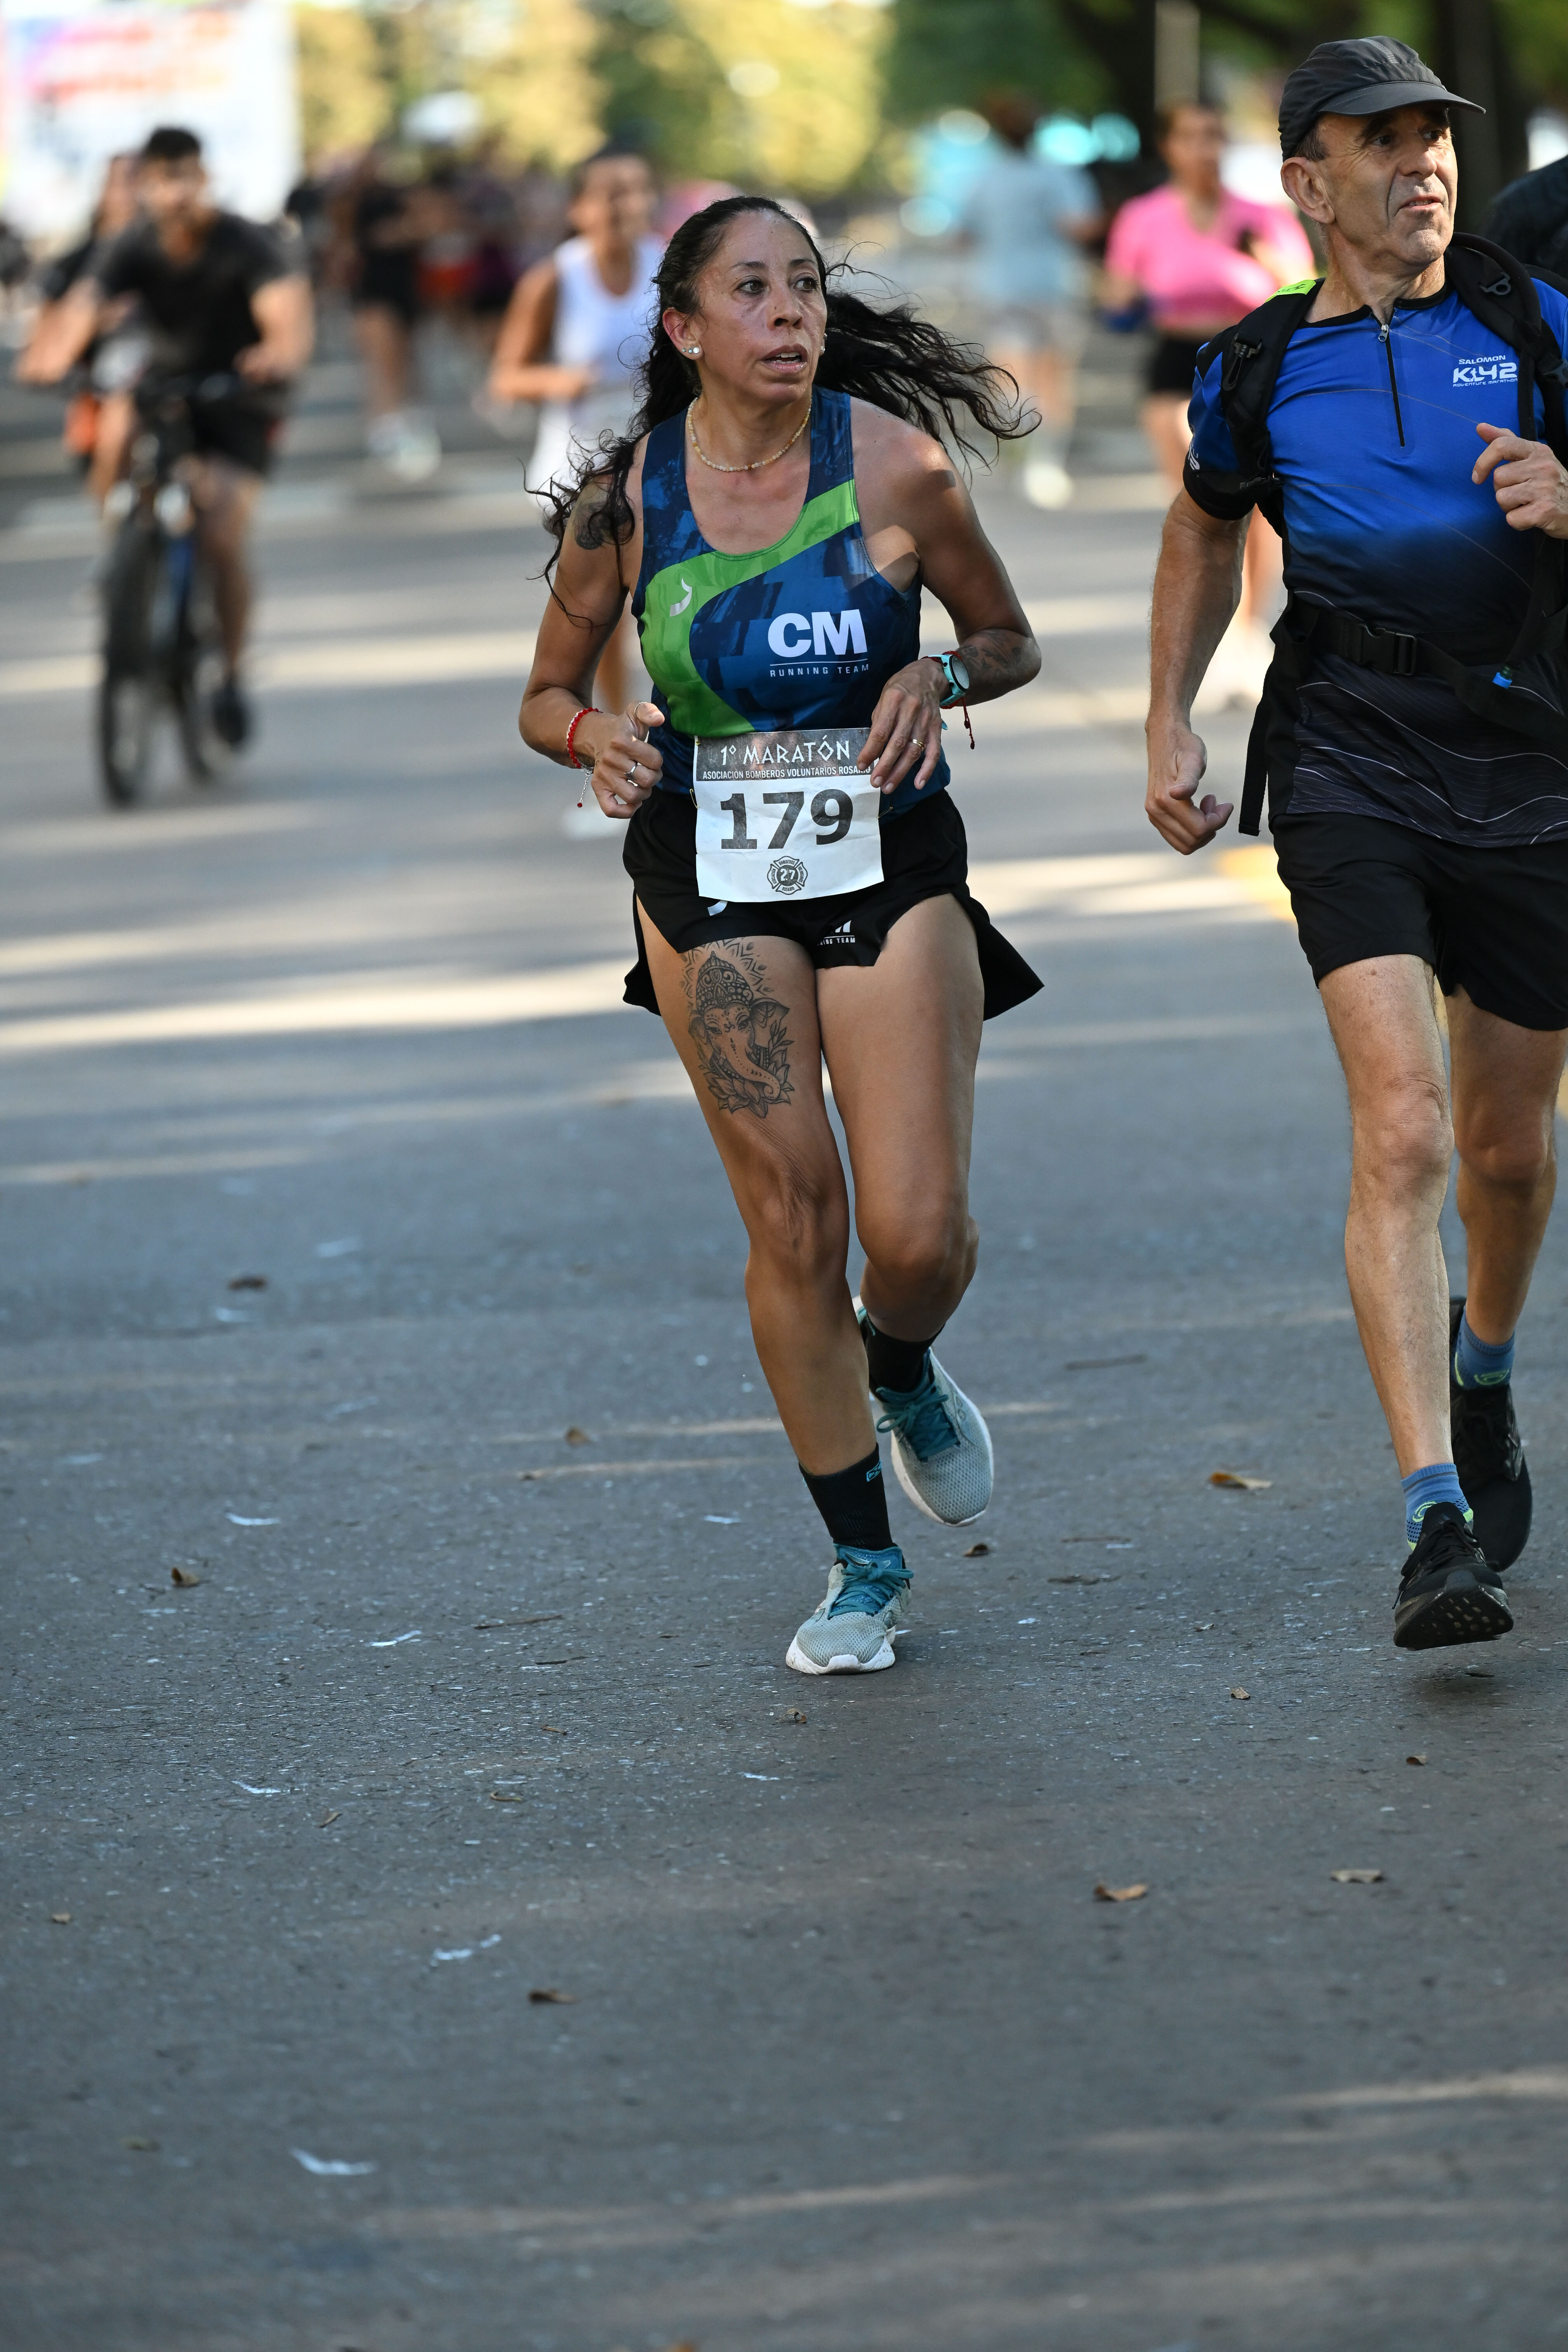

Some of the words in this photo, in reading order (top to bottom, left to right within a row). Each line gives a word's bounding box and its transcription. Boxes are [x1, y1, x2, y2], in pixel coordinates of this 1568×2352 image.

[1459, 355, 1506, 364] SALOMON
[768, 609, 867, 657] CM
[770, 667, 828, 677] RUNNING
[837, 664, 869, 674] TEAM
[743, 735, 850, 765] MARATÓN
[703, 769, 744, 780] ASOCIACIÓN
[746, 768, 785, 778] BOMBEROS
[787, 766, 836, 777] VOLUNTARIOS
[720, 789, 853, 849] 179
[780, 868, 796, 881] 27
